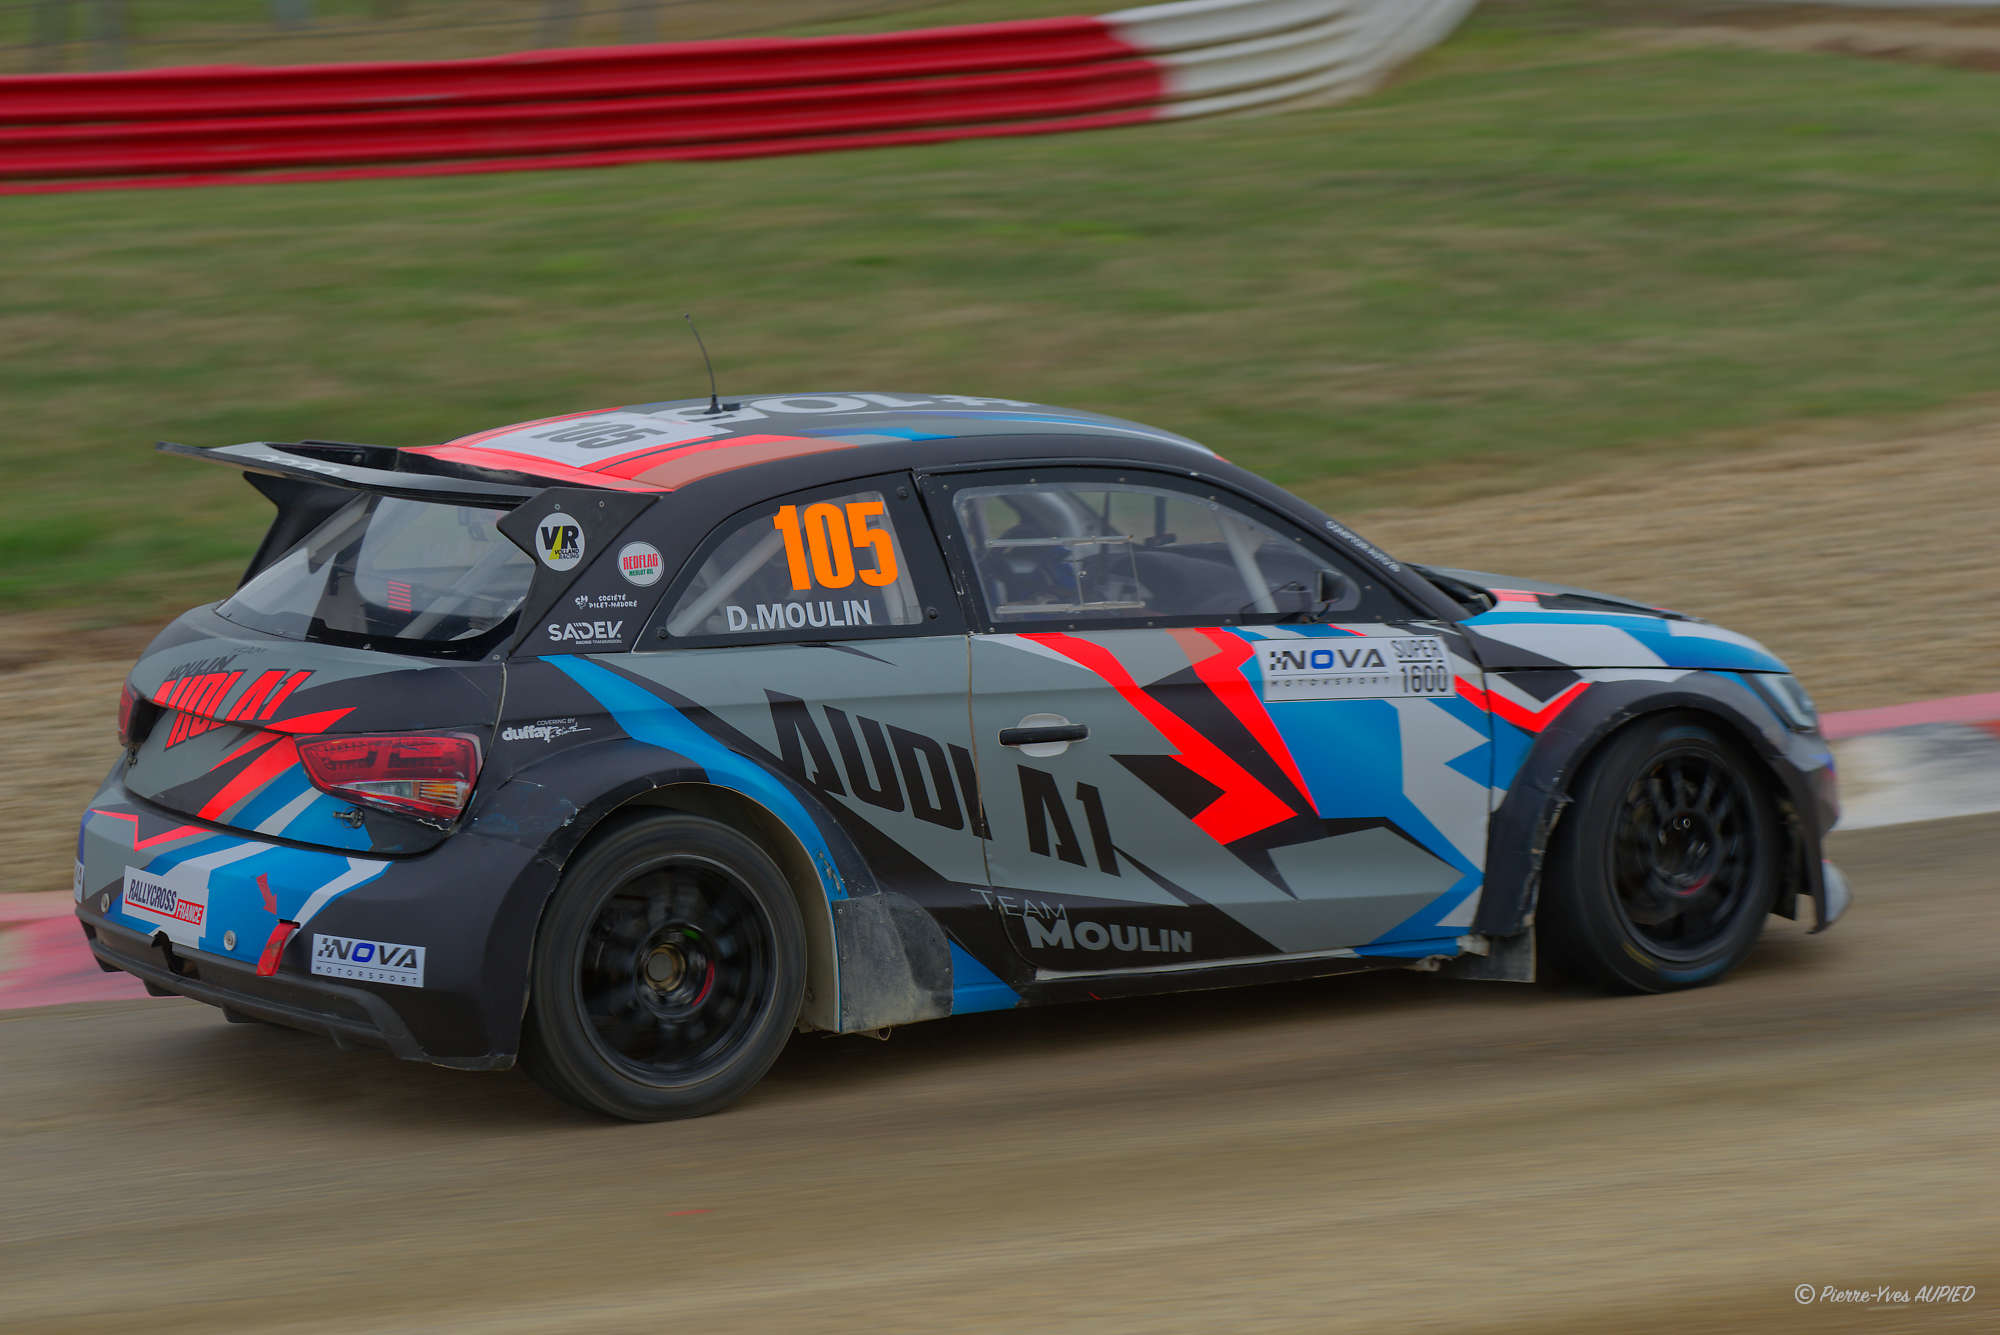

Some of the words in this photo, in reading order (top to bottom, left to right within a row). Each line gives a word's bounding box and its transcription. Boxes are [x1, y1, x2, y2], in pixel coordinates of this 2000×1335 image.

[530, 421, 668, 450] 105
[623, 552, 659, 571] REDFLAG
[772, 501, 899, 591] 105
[726, 600, 873, 632] D.MOULIN
[1271, 648, 1387, 671] NOVA
[1391, 638, 1444, 659] SUPER
[1400, 664, 1448, 693] 1600
[763, 688, 993, 842] AUDI
[1016, 763, 1121, 879] A1
[127, 878, 178, 912] RALLYCROSS
[176, 899, 203, 925] FRANCE
[970, 888, 1069, 921] TEAM
[1023, 914, 1193, 953] MOULIN
[318, 937, 418, 969] NOVA
